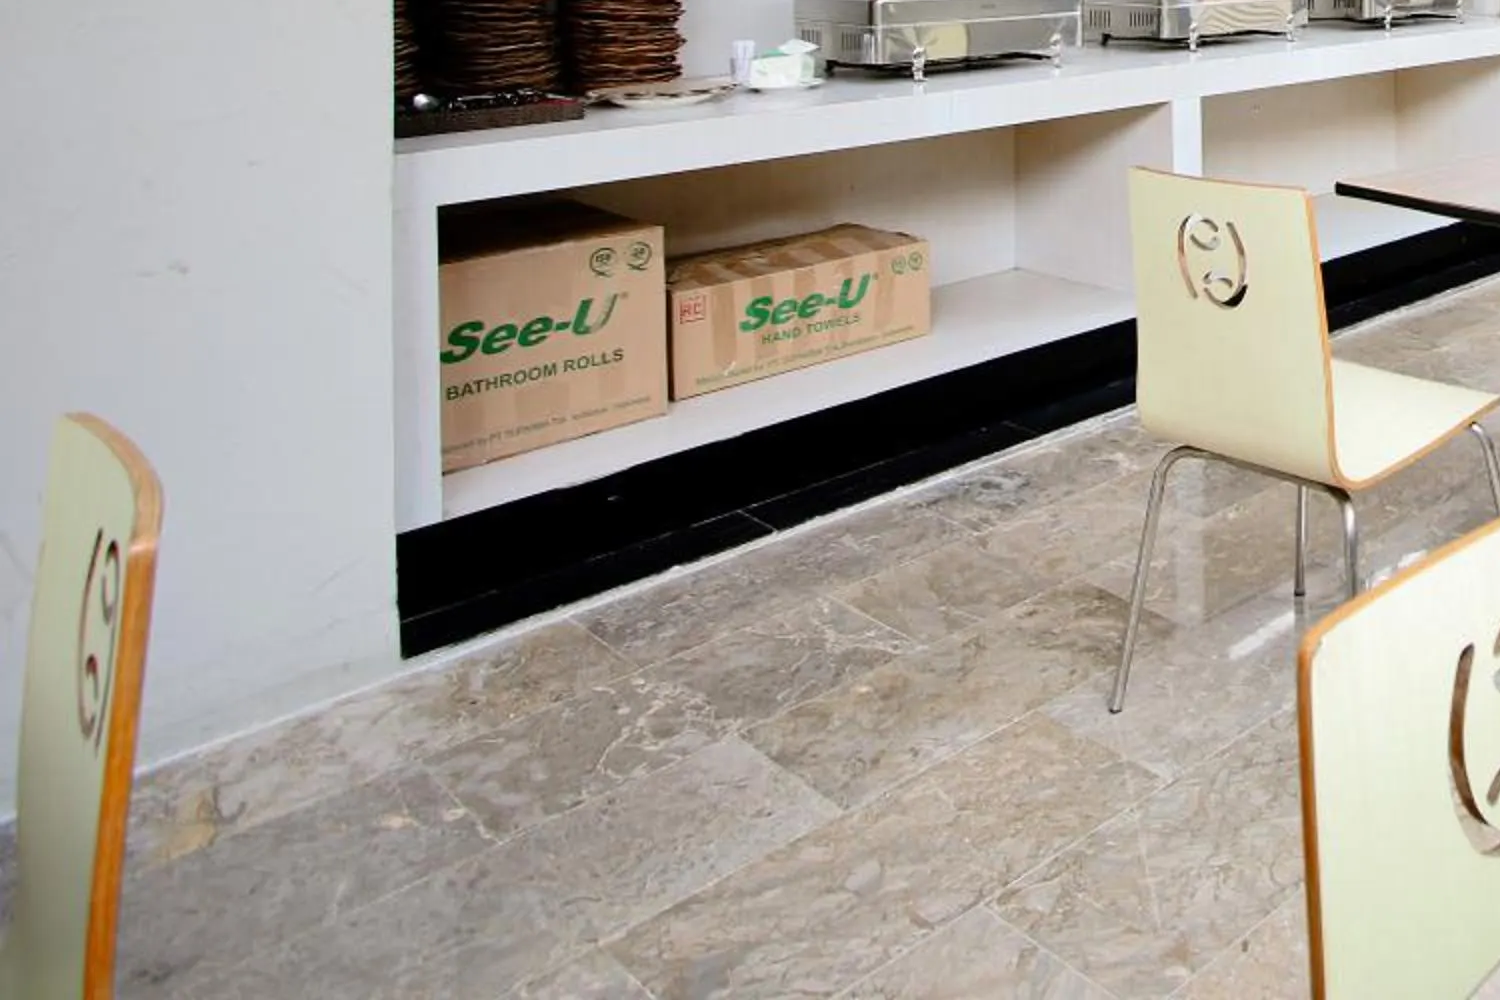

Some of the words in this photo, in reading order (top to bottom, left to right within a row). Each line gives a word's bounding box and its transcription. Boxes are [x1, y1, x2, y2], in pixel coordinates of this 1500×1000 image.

[440, 293, 618, 363] See-U
[739, 273, 872, 332] See-U
[761, 325, 801, 345] HAND
[806, 314, 861, 335] TOWELS
[446, 362, 558, 401] BATHROOM
[562, 347, 625, 373] ROLLS
